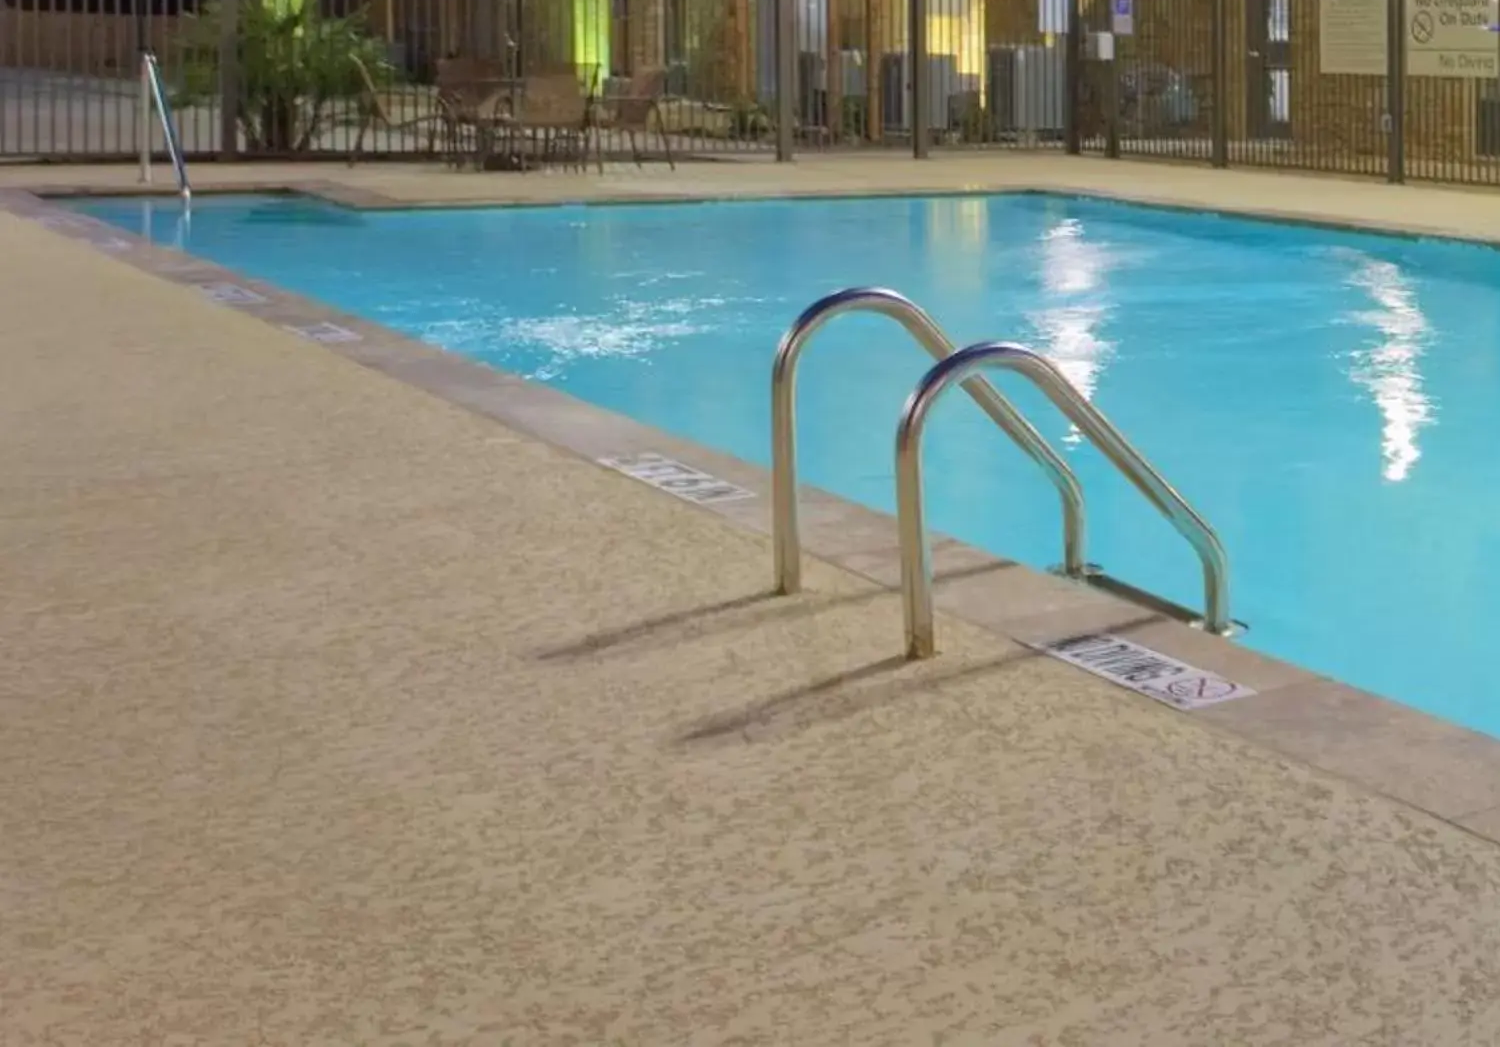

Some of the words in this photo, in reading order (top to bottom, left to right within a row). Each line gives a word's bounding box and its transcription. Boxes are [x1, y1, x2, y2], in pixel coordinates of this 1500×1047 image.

[1440, 12, 1457, 26] On
[1461, 12, 1489, 27] Duty
[1440, 54, 1456, 68] No
[1458, 54, 1494, 72] Diving
